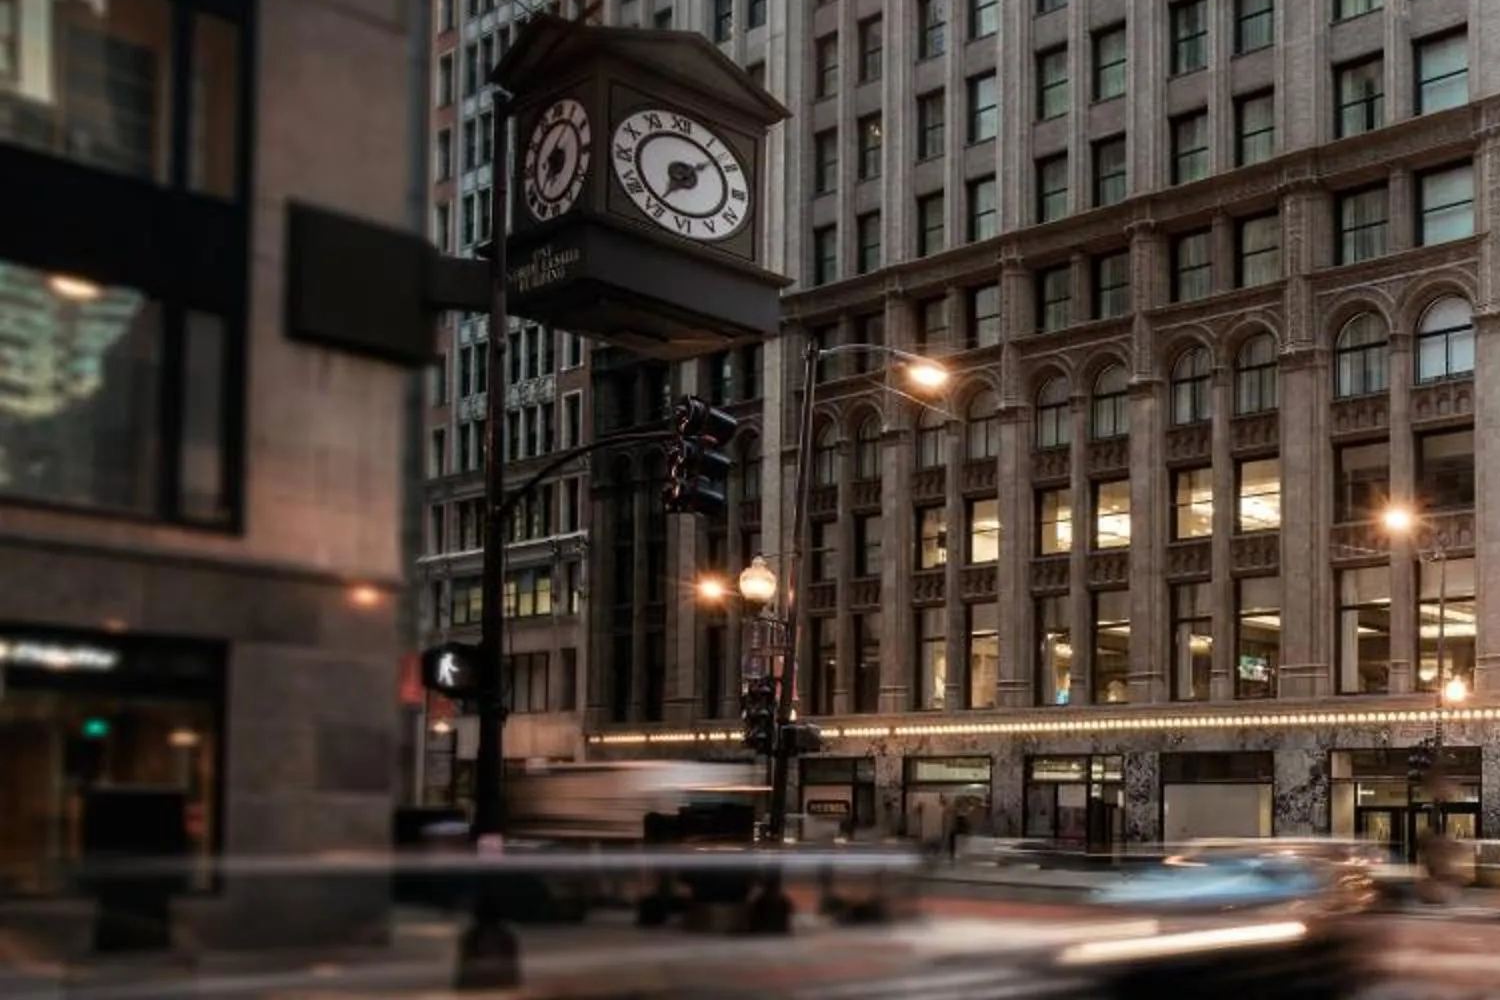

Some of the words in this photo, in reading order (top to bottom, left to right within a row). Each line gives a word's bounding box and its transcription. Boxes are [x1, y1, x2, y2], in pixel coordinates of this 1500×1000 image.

[623, 122, 641, 141] X
[671, 115, 692, 135] XII
[673, 215, 692, 234] VI
[703, 219, 717, 234] V
